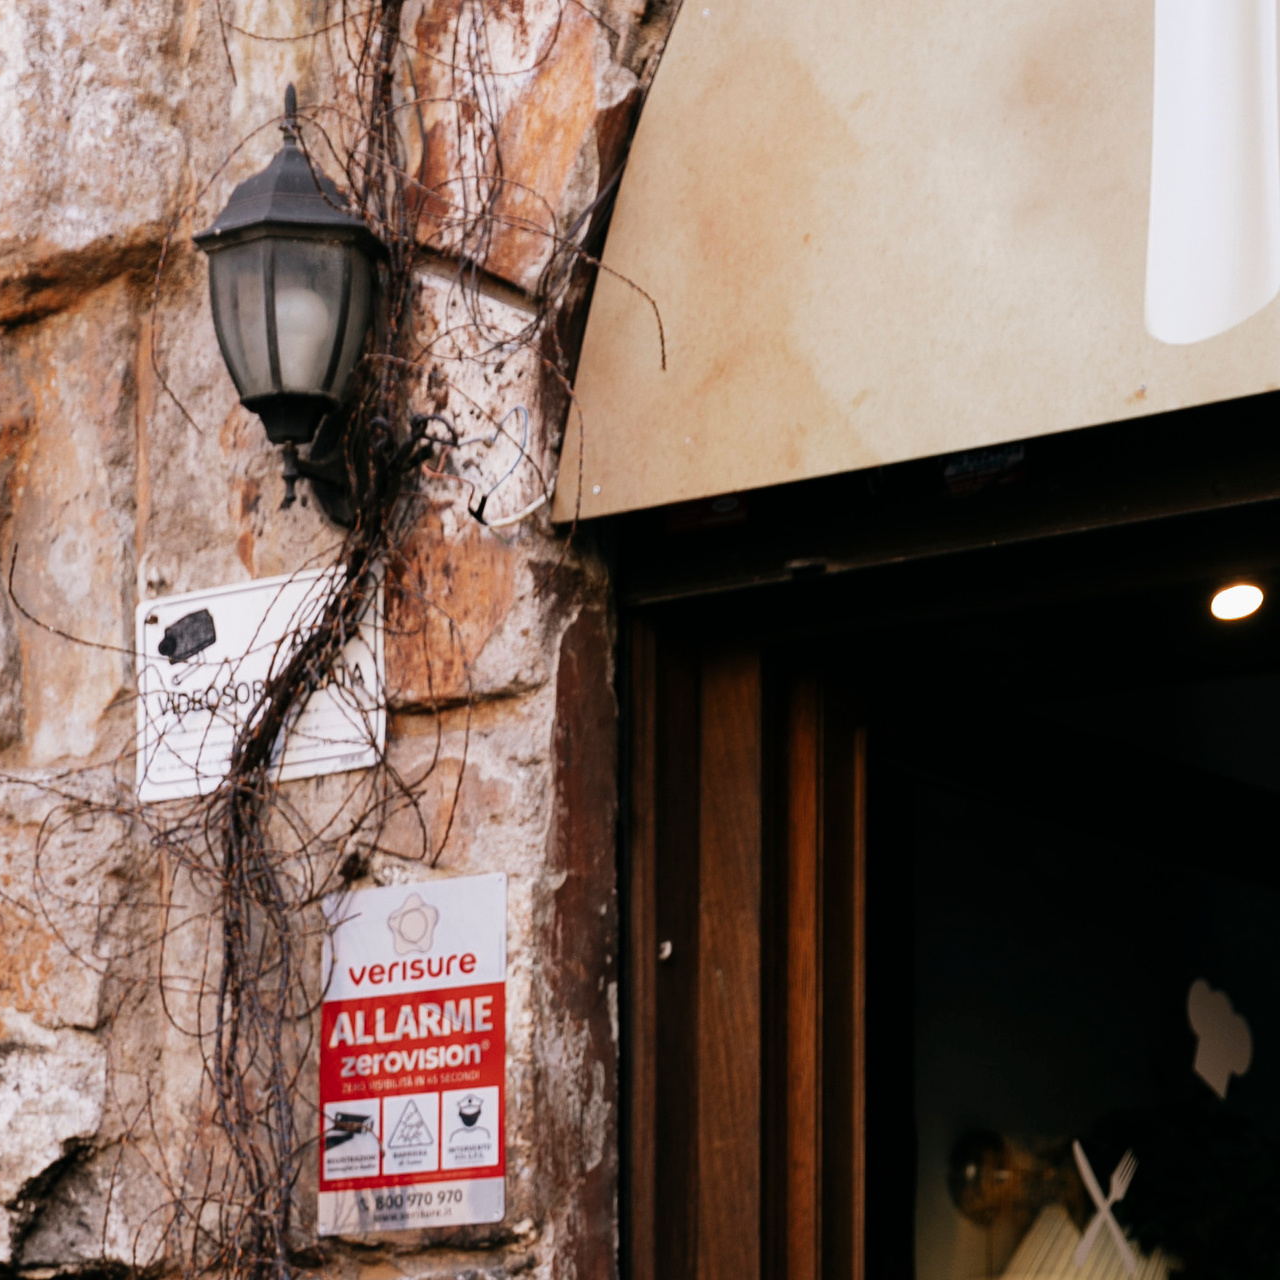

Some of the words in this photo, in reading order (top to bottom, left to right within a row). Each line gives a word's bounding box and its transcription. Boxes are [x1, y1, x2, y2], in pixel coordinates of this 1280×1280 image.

[349, 952, 477, 986] verisure
[329, 995, 493, 1049] ALLARME
[375, 1194, 404, 1211] 800
[406, 1191, 434, 1207] 970
[437, 1188, 464, 1204] 970
